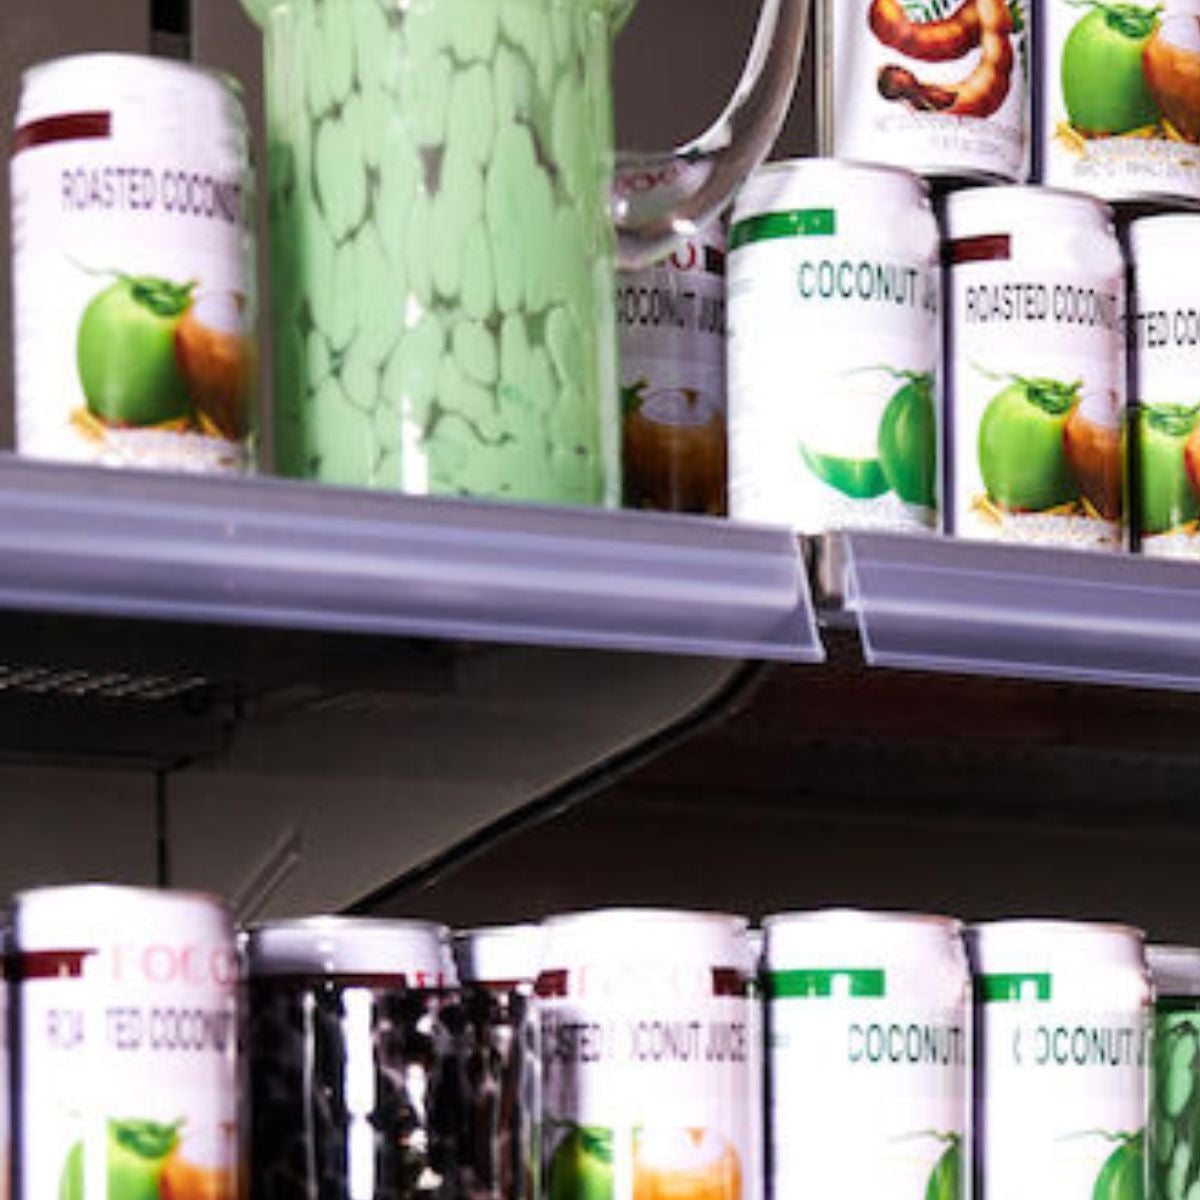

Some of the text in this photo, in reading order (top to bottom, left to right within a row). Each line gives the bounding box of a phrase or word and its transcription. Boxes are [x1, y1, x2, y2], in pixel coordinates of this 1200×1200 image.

[61, 166, 155, 212] ROASTED
[798, 259, 919, 308] COCONUT
[966, 284, 1047, 322] ROASTED
